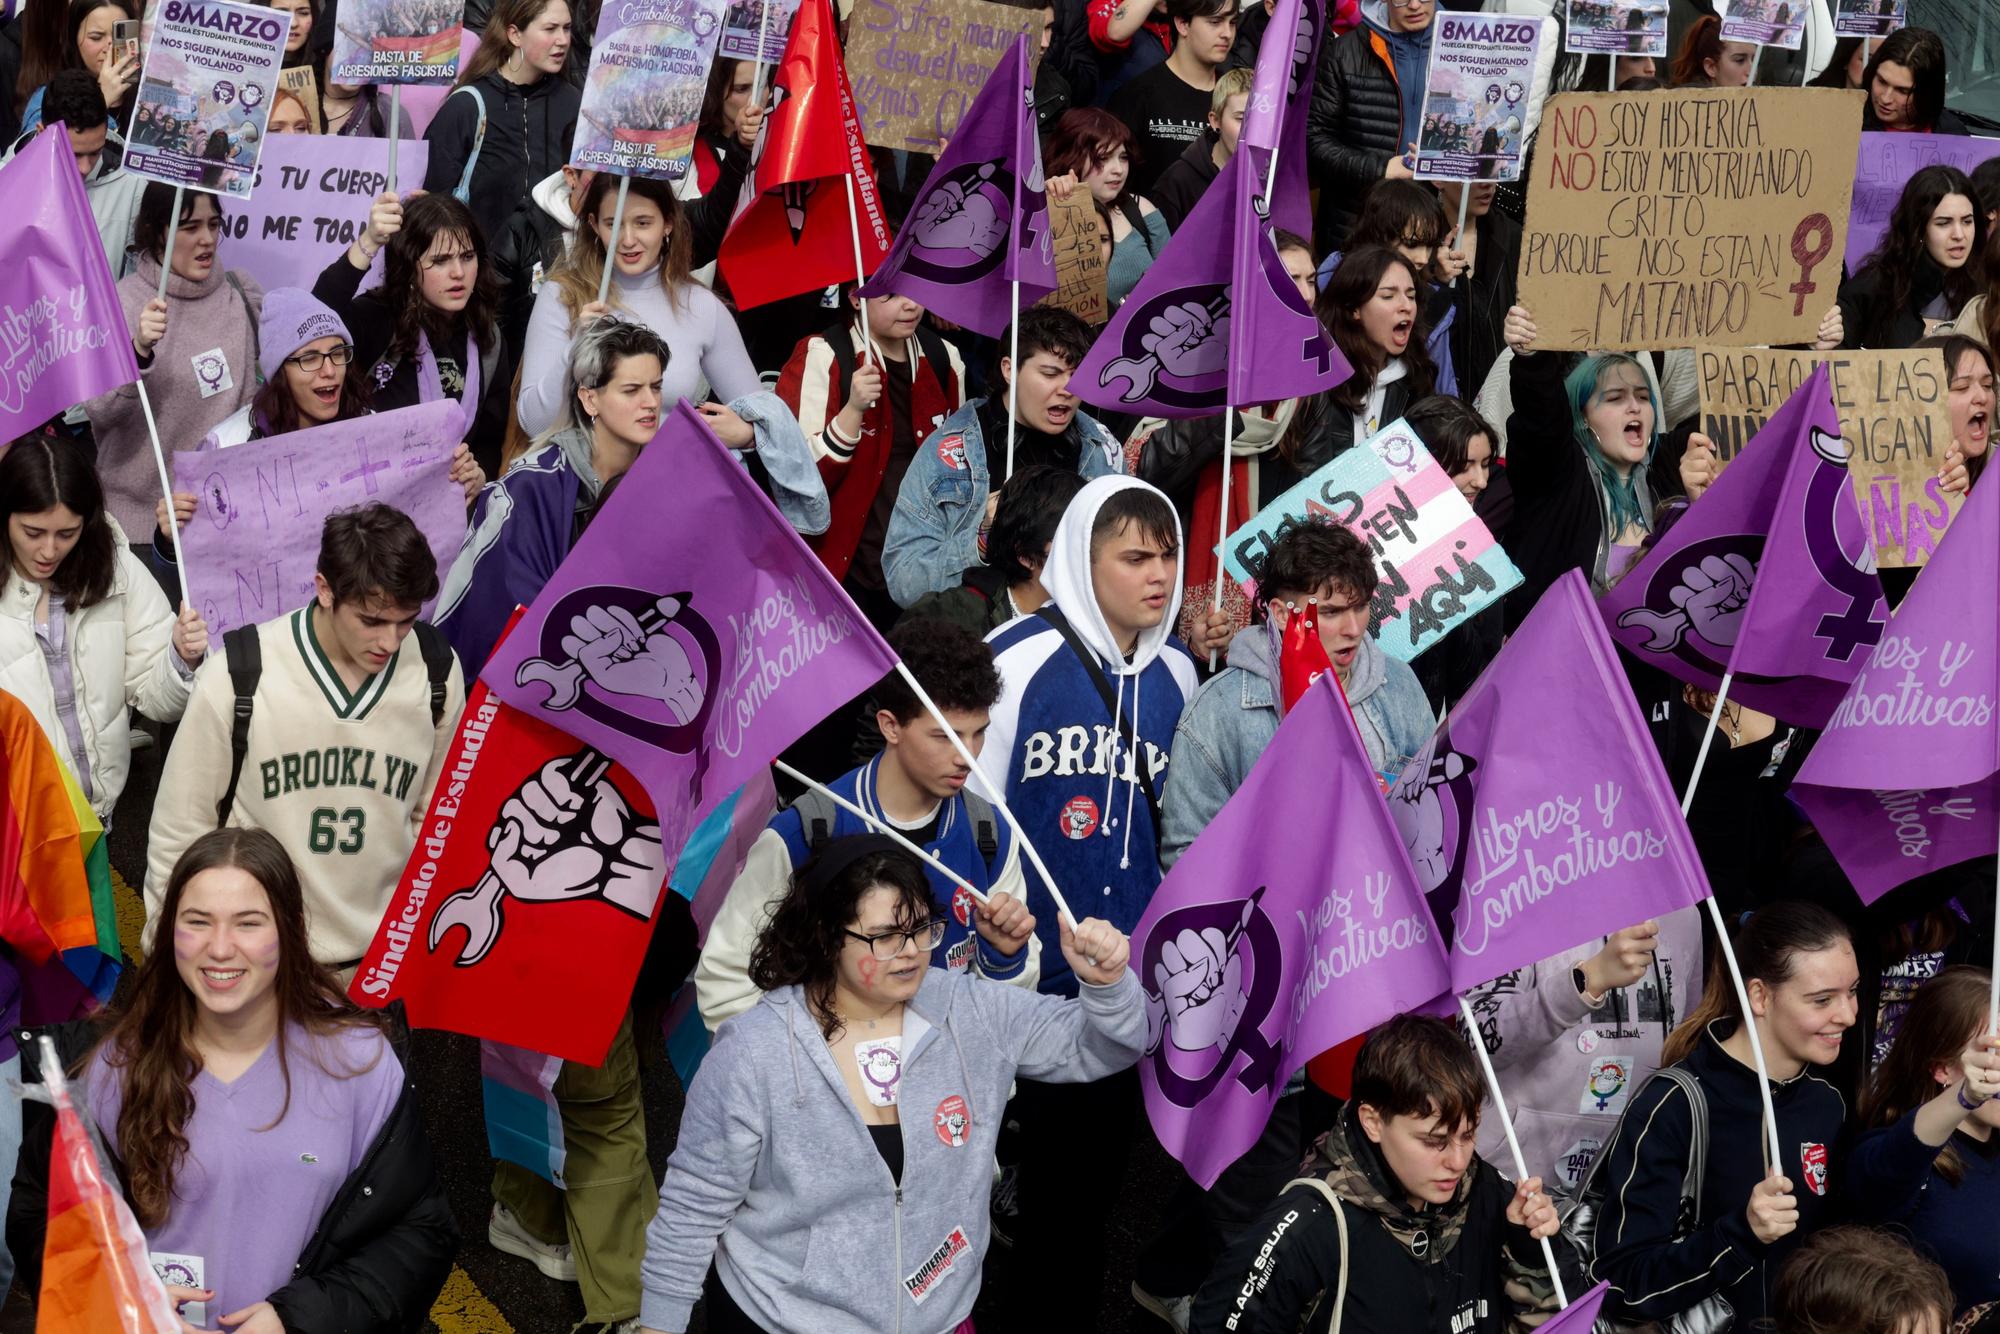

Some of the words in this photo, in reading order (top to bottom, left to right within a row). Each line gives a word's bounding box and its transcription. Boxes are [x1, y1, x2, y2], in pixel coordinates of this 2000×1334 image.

[165, 1, 281, 42] 8MARZO
[618, 3, 687, 26] Combativas
[1442, 20, 1535, 44] 8MARZO
[161, 37, 182, 49] NOS
[184, 41, 220, 57] SIGUEN
[221, 49, 271, 67] MATANDO
[163, 23, 192, 35] HUELGA
[193, 28, 241, 43] ESTUDIANTIL
[239, 38, 276, 52] FEMINISTA
[608, 41, 630, 53] BASTA
[632, 45, 641, 53] DE
[1441, 41, 1466, 49] HUELGA
[1467, 43, 1501, 51] ESTUDIANTIL
[185, 53, 193, 62] Y
[192, 55, 244, 73] VIOLANDO
[338, 64, 399, 77] AGRESIONES
[401, 65, 455, 78] FASCISTAS
[373, 51, 404, 63] BASTA
[409, 51, 423, 63] DE
[600, 52, 655, 71] MACHISMO
[661, 61, 704, 77] RACISMO
[1440, 54, 1457, 62] NOS
[1459, 55, 1491, 65] SIGUEN
[1491, 57, 1528, 66] MATANDO
[1460, 65, 1465, 73] Y
[1466, 66, 1507, 76] VIOLANDO
[286, 70, 311, 89] HOY
[1553, 105, 1597, 149] NO
[1603, 102, 1649, 148] SOY
[577, 149, 636, 168] AGRESIONES
[636, 157, 686, 173] FASCISTAS
[612, 140, 641, 154] BASTA
[643, 143, 657, 156] DE
[280, 166, 310, 191] TU
[320, 167, 397, 198] CUERP
[844, 117, 889, 251] Estudiantes
[1550, 151, 1596, 191] NO
[1601, 149, 1651, 193] ESTOY
[1658, 148, 1813, 200] MENSTRUANDO
[219, 215, 249, 240] NO
[262, 215, 302, 241] ME
[1078, 221, 1096, 236] NO
[1607, 195, 1705, 238] GRITO
[1078, 240, 1096, 254] ES
[1081, 256, 1102, 273] UNA
[1525, 232, 1612, 277] PORQUE
[1637, 238, 1685, 277] NOS
[1700, 234, 1781, 279] ESTAN
[69, 283, 89, 322] y
[1595, 279, 1750, 345] MATANDO
[297, 313, 341, 340] BROOKLYN
[1702, 352, 1783, 406] PARA
[1876, 358, 1938, 404] LAS
[1938, 640, 1975, 688] y
[434, 690, 501, 819] Estudian
[260, 746, 418, 802] BROOKLYN
[308, 806, 367, 856] 63
[424, 819, 452, 861] de
[1471, 795, 1582, 896] Libres
[1594, 781, 1623, 829] y
[1365, 871, 1391, 919] y
[1455, 824, 1667, 956] Combativas
[361, 860, 438, 999] Sindicato
[905, 1240, 951, 1292] IZQUIERDA
[911, 1239, 968, 1298] REVOLUCIOARIA
[1225, 1271, 1258, 1331] BLACK
[1254, 1210, 1299, 1270] SQUAD
[1256, 1257, 1276, 1293] PROJECTS
